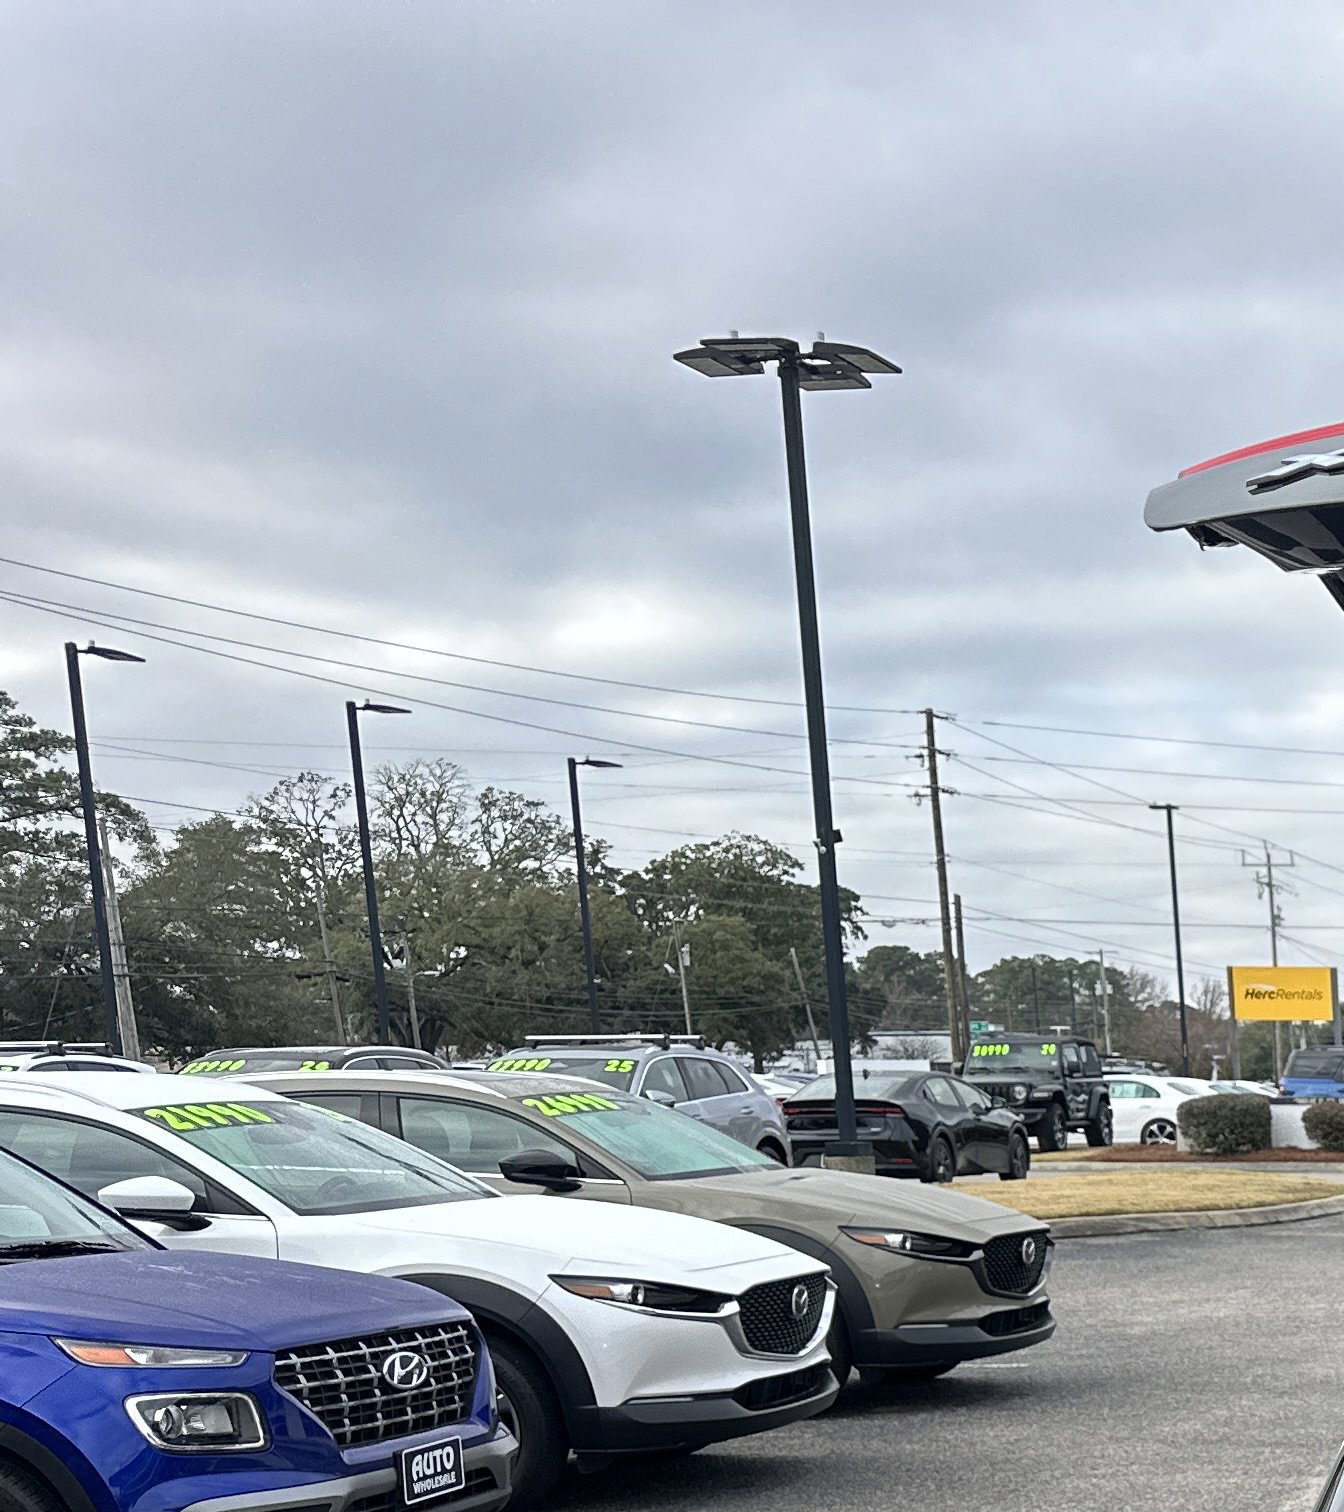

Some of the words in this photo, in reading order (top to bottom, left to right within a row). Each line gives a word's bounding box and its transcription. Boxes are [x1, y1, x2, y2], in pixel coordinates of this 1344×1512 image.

[604, 1060, 634, 1072] 25
[143, 1102, 276, 1131] 21990
[411, 1445, 455, 1482] AUTO
